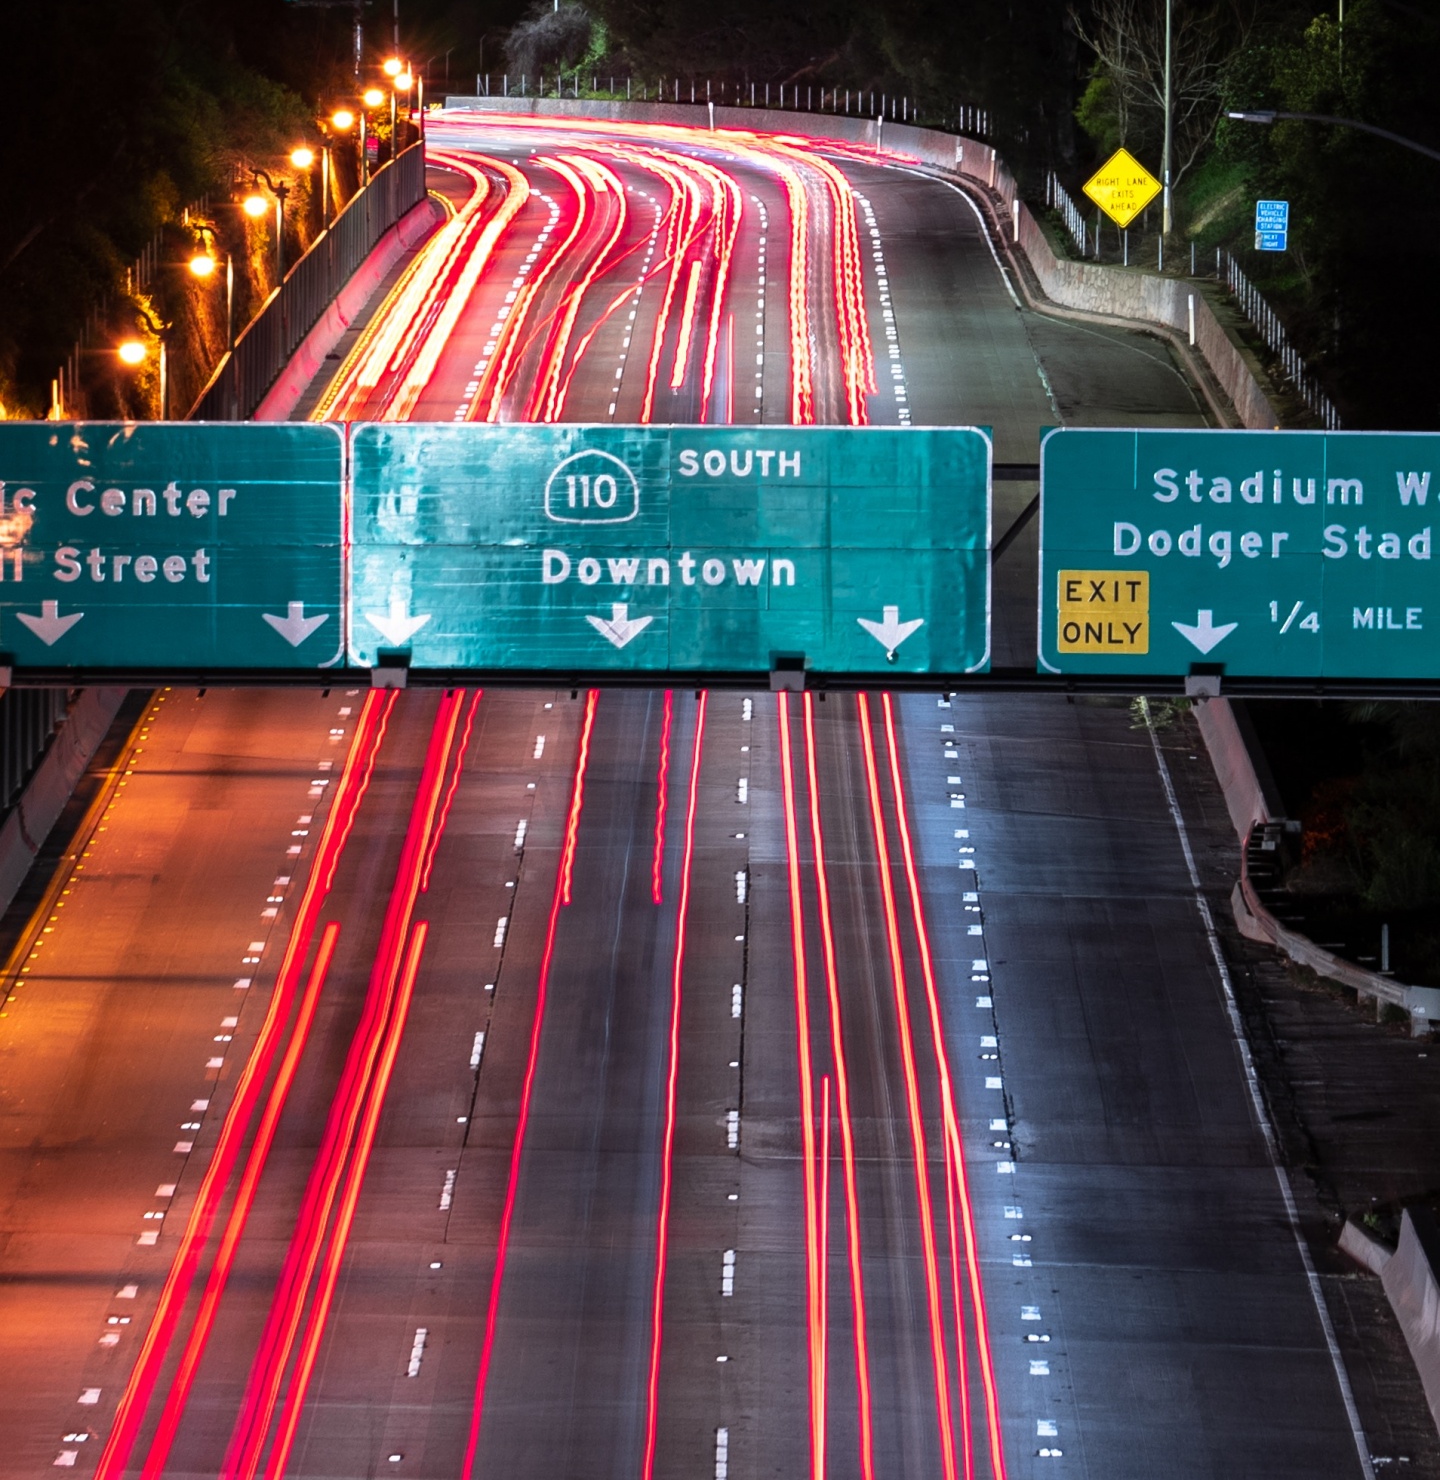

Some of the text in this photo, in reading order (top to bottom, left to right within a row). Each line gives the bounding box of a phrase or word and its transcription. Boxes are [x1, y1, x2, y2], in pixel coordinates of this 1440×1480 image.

[1096, 178, 1119, 186] RIGHT
[1112, 190, 1134, 198] EXITS
[679, 449, 801, 477] SOUTH
[66, 480, 236, 519] Center
[566, 474, 617, 508] 110
[1153, 468, 1440, 506] Stadium W
[1113, 522, 1431, 569] Dodger Stad
[54, 546, 210, 583] Street
[542, 549, 795, 586] Downtown
[1066, 580, 1142, 603] EXIT
[1063, 621, 1142, 644] ONLY
[1269, 600, 1422, 634] 1/4 MILE
